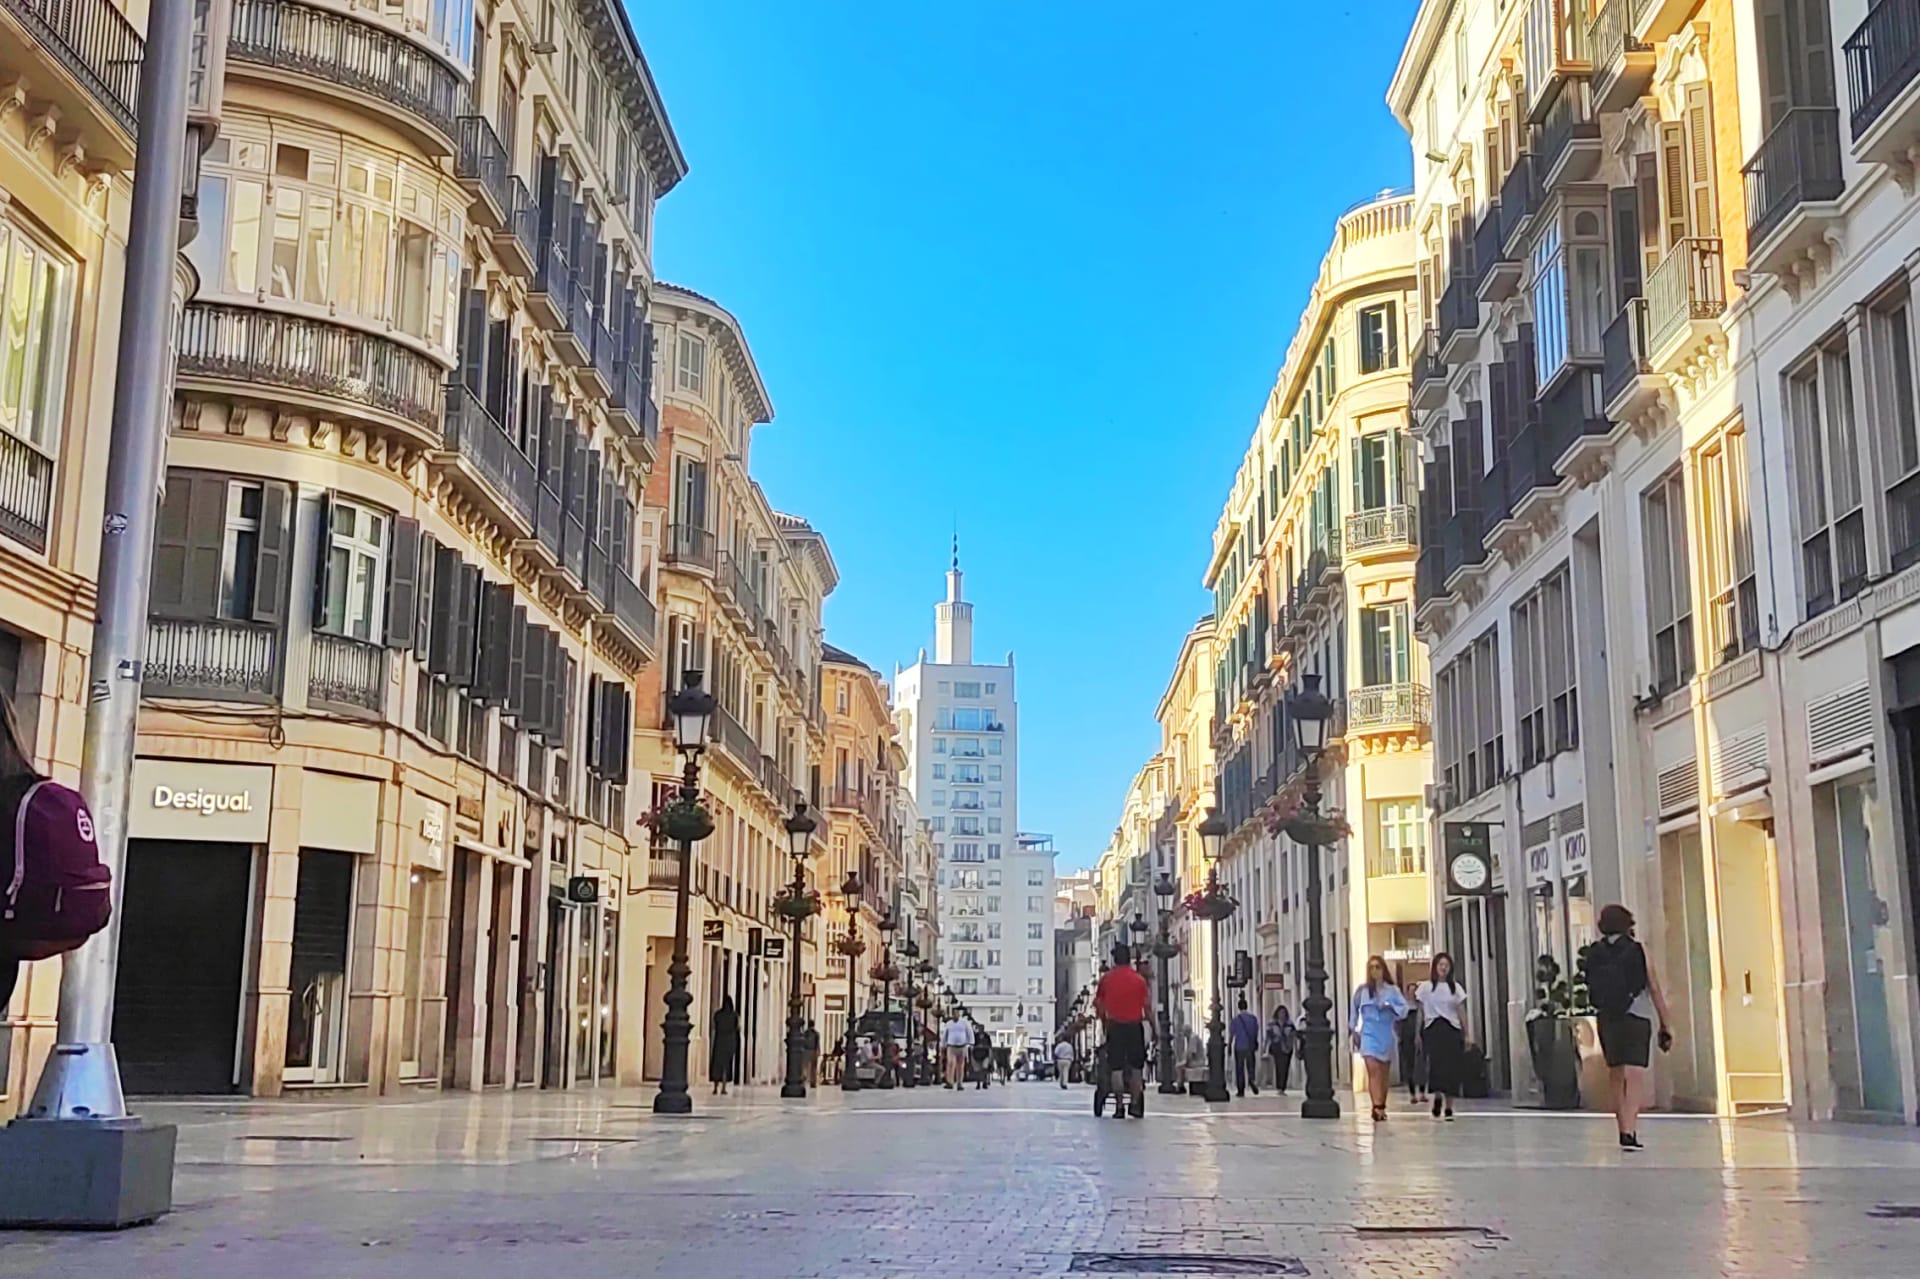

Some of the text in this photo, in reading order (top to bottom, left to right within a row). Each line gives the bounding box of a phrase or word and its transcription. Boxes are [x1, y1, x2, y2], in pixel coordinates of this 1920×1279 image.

[153, 784, 253, 815] Desigual.
[1530, 846, 1549, 873] KIKO
[1565, 832, 1586, 862] KIKO
